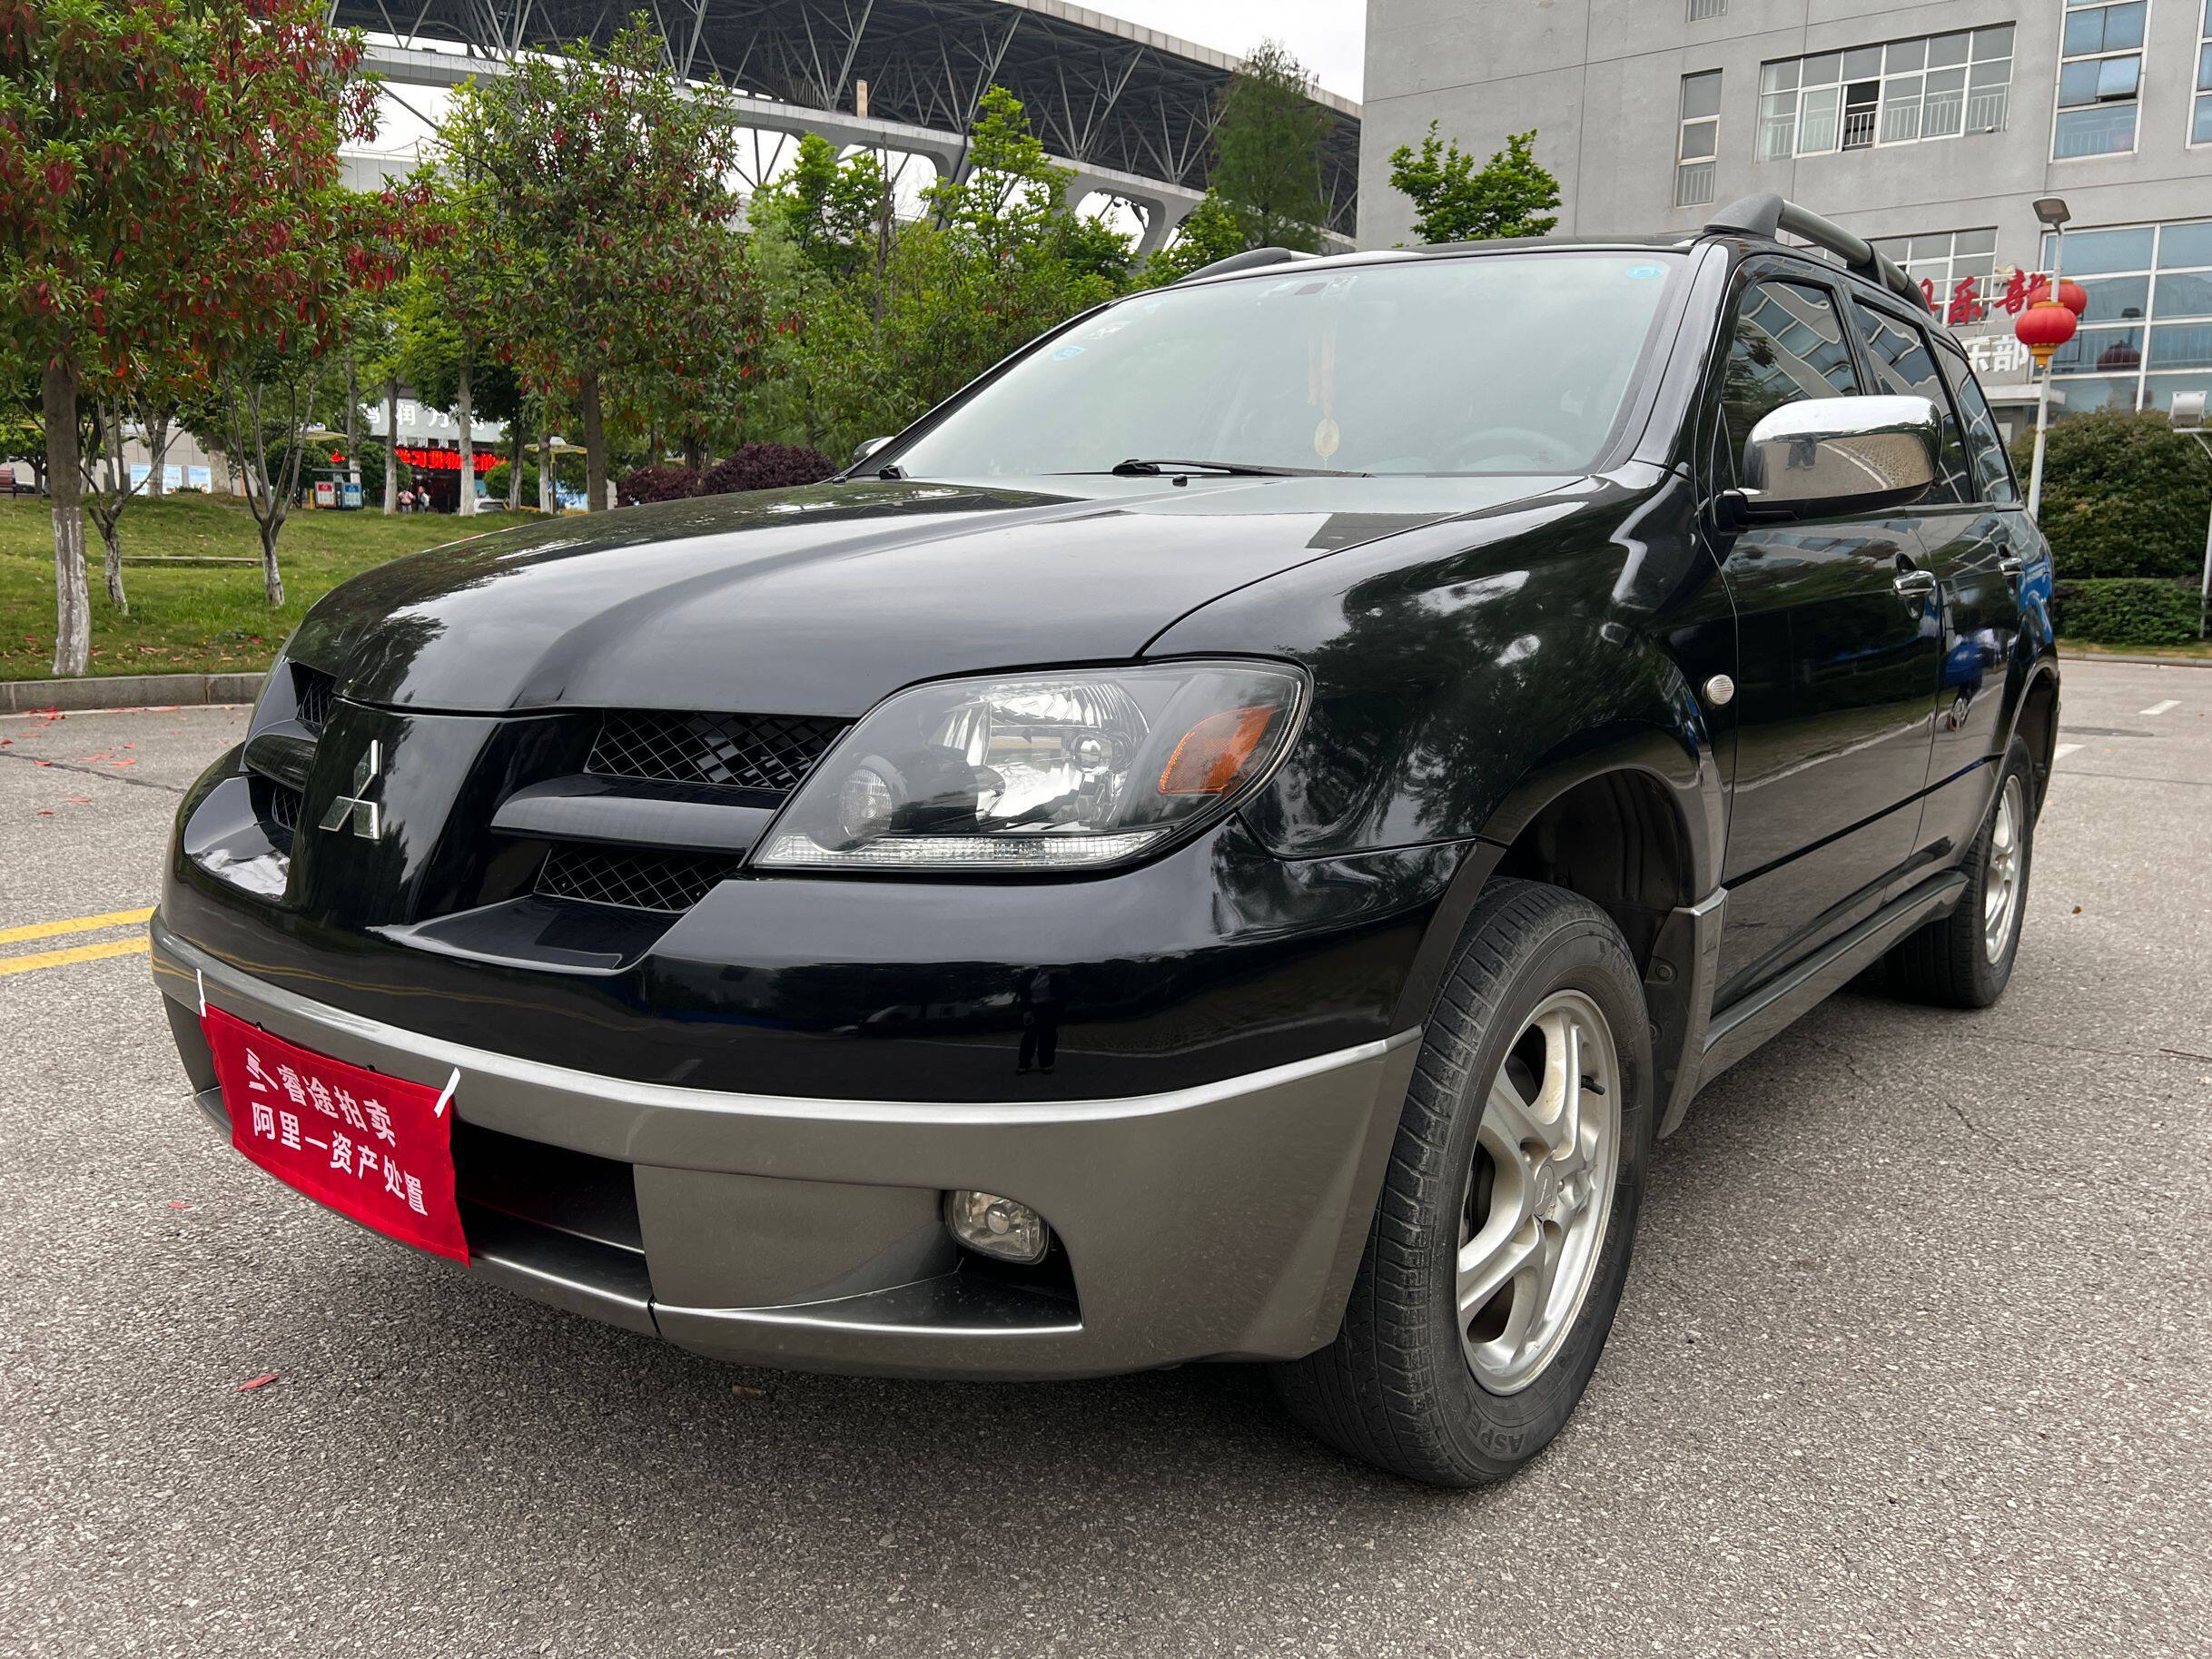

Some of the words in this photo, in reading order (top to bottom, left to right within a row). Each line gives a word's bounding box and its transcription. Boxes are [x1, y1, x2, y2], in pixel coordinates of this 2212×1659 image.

[252, 1101, 429, 1217] 阿里一资产处置
